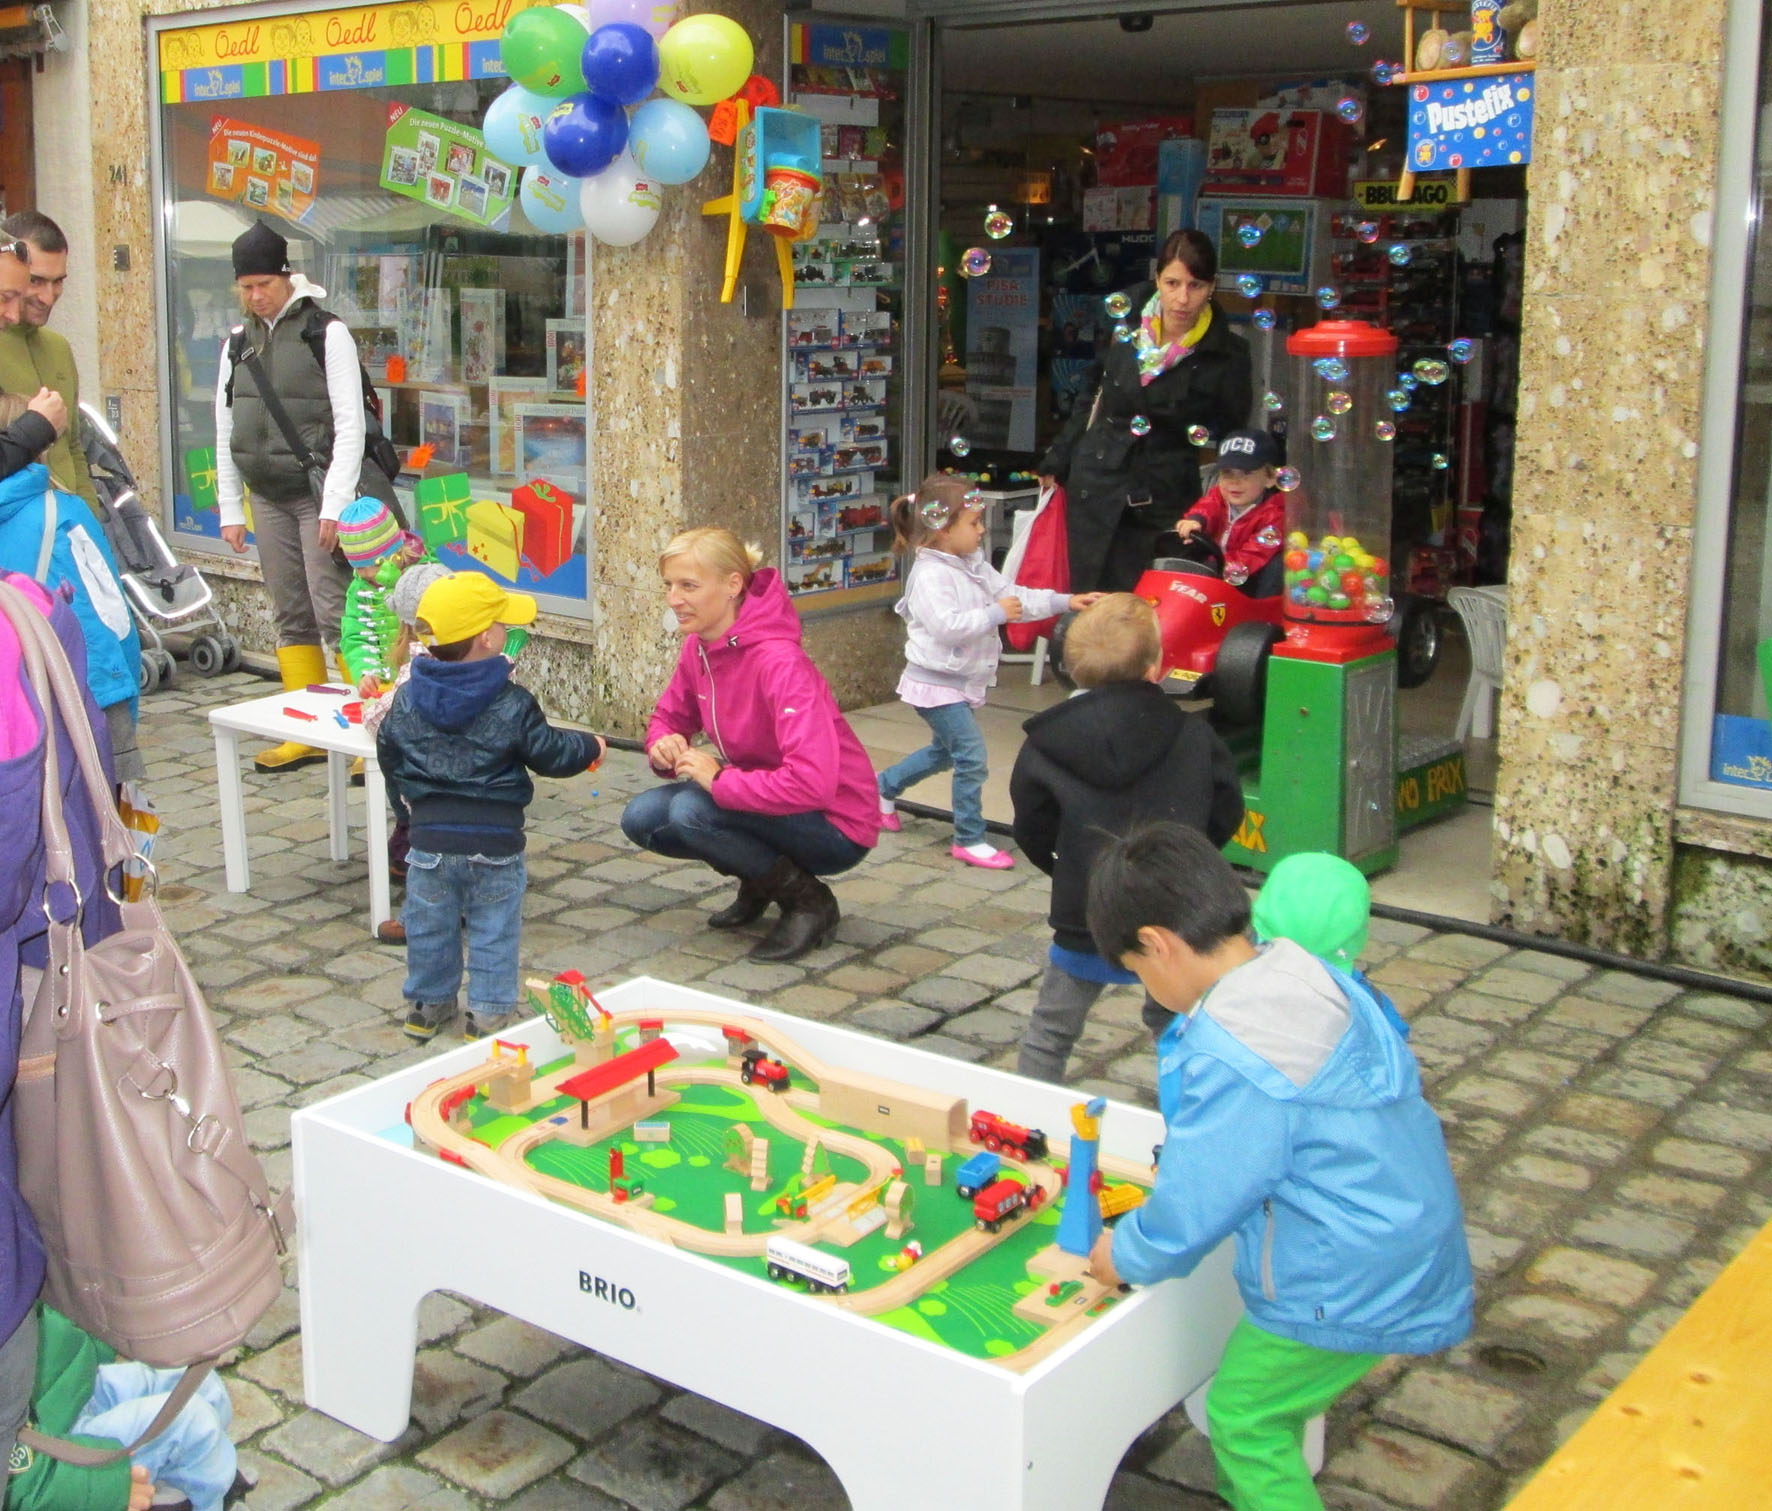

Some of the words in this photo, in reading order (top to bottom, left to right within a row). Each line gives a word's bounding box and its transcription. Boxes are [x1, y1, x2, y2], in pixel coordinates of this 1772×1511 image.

[325, 12, 377, 47] Oedl
[454, 0, 512, 34] Oedl
[215, 25, 261, 59] Oedl
[390, 106, 404, 123] NEU
[420, 120, 440, 130] neuen
[1426, 83, 1516, 135] Pustefix
[1365, 185, 1449, 205] BBUAGO
[578, 1269, 636, 1310] BRIO
